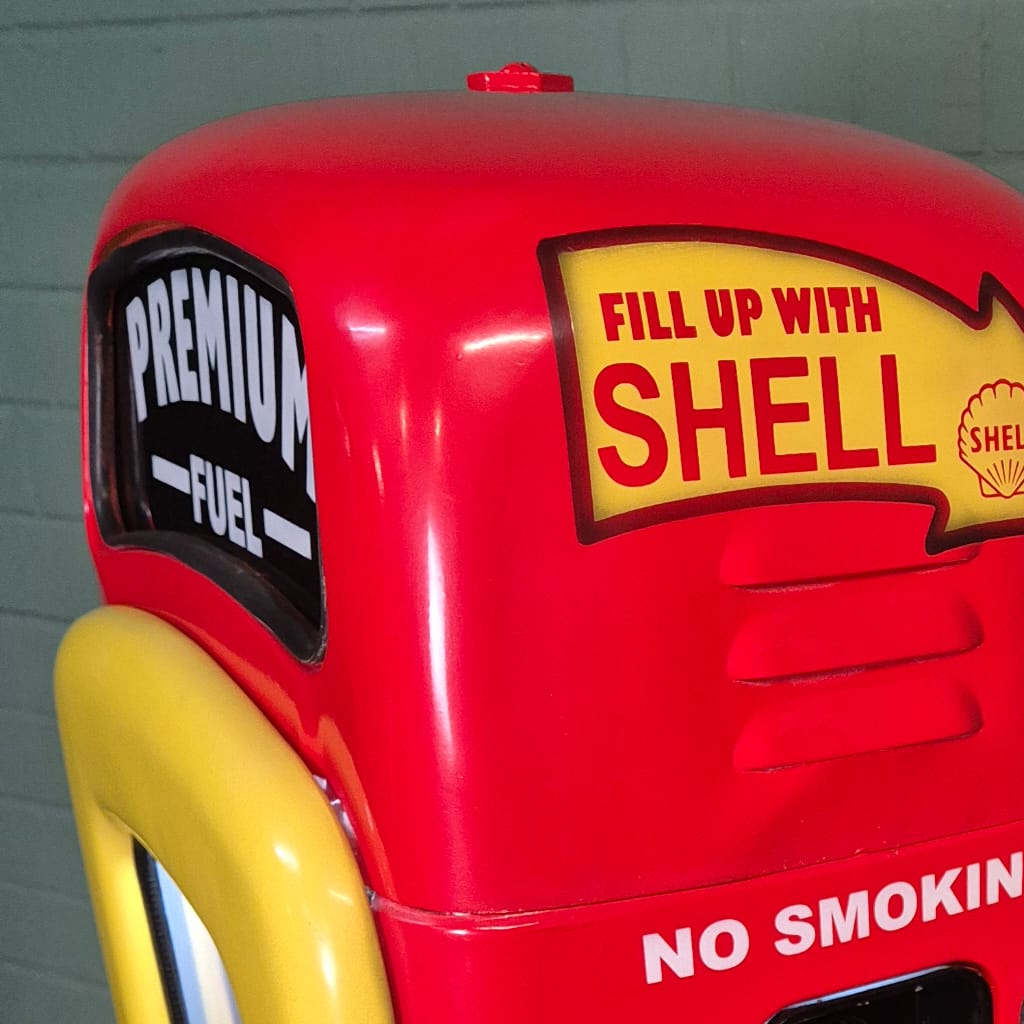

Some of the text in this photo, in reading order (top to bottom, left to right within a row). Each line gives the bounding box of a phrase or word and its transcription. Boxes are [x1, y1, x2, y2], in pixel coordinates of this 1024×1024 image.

[599, 286, 882, 341] FILL UP WITH
[126, 266, 316, 503] PREMIUM
[593, 354, 937, 488] SHELL
[189, 453, 264, 558] FUEL
[642, 918, 750, 985] NO
